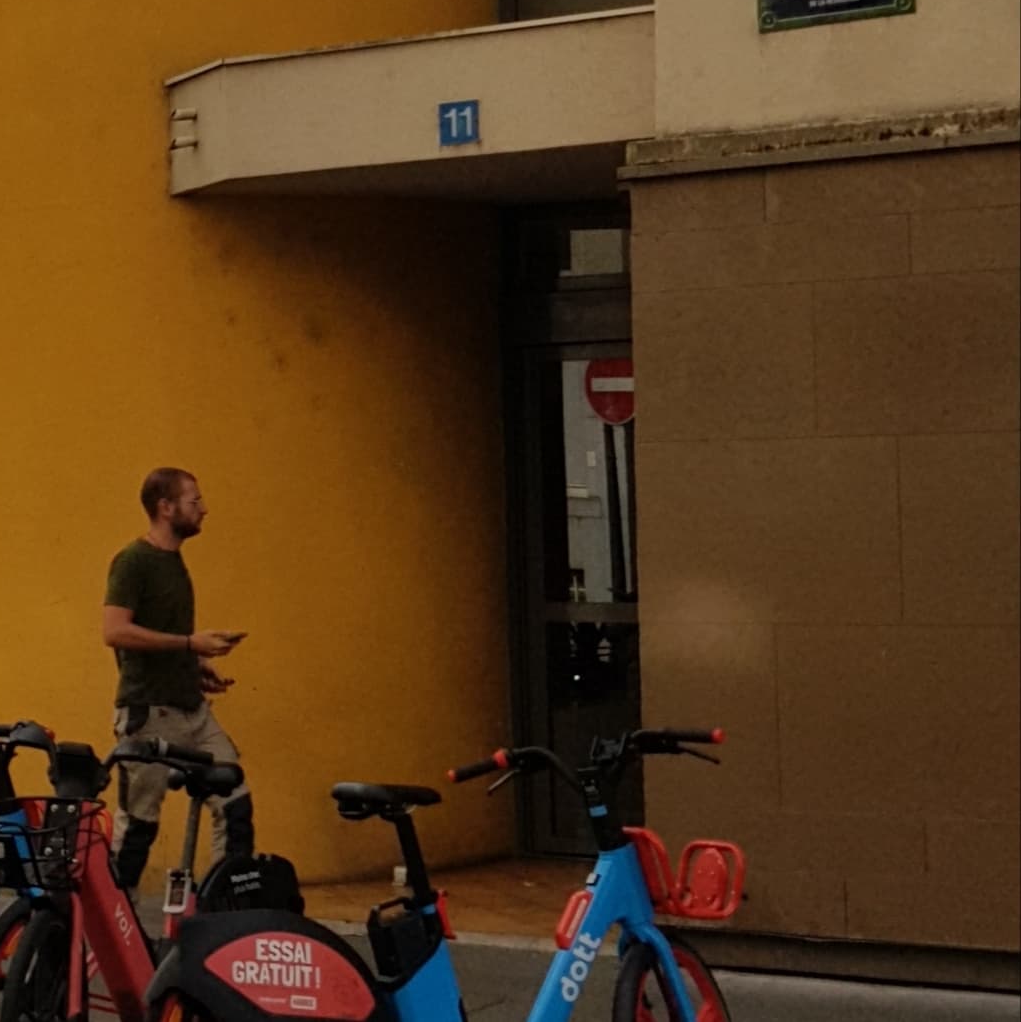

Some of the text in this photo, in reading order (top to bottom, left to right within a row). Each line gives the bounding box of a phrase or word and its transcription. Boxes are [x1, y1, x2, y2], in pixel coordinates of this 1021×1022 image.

[443, 106, 473, 138] 11
[255, 938, 312, 964] ESSAI
[561, 932, 603, 1003] dott
